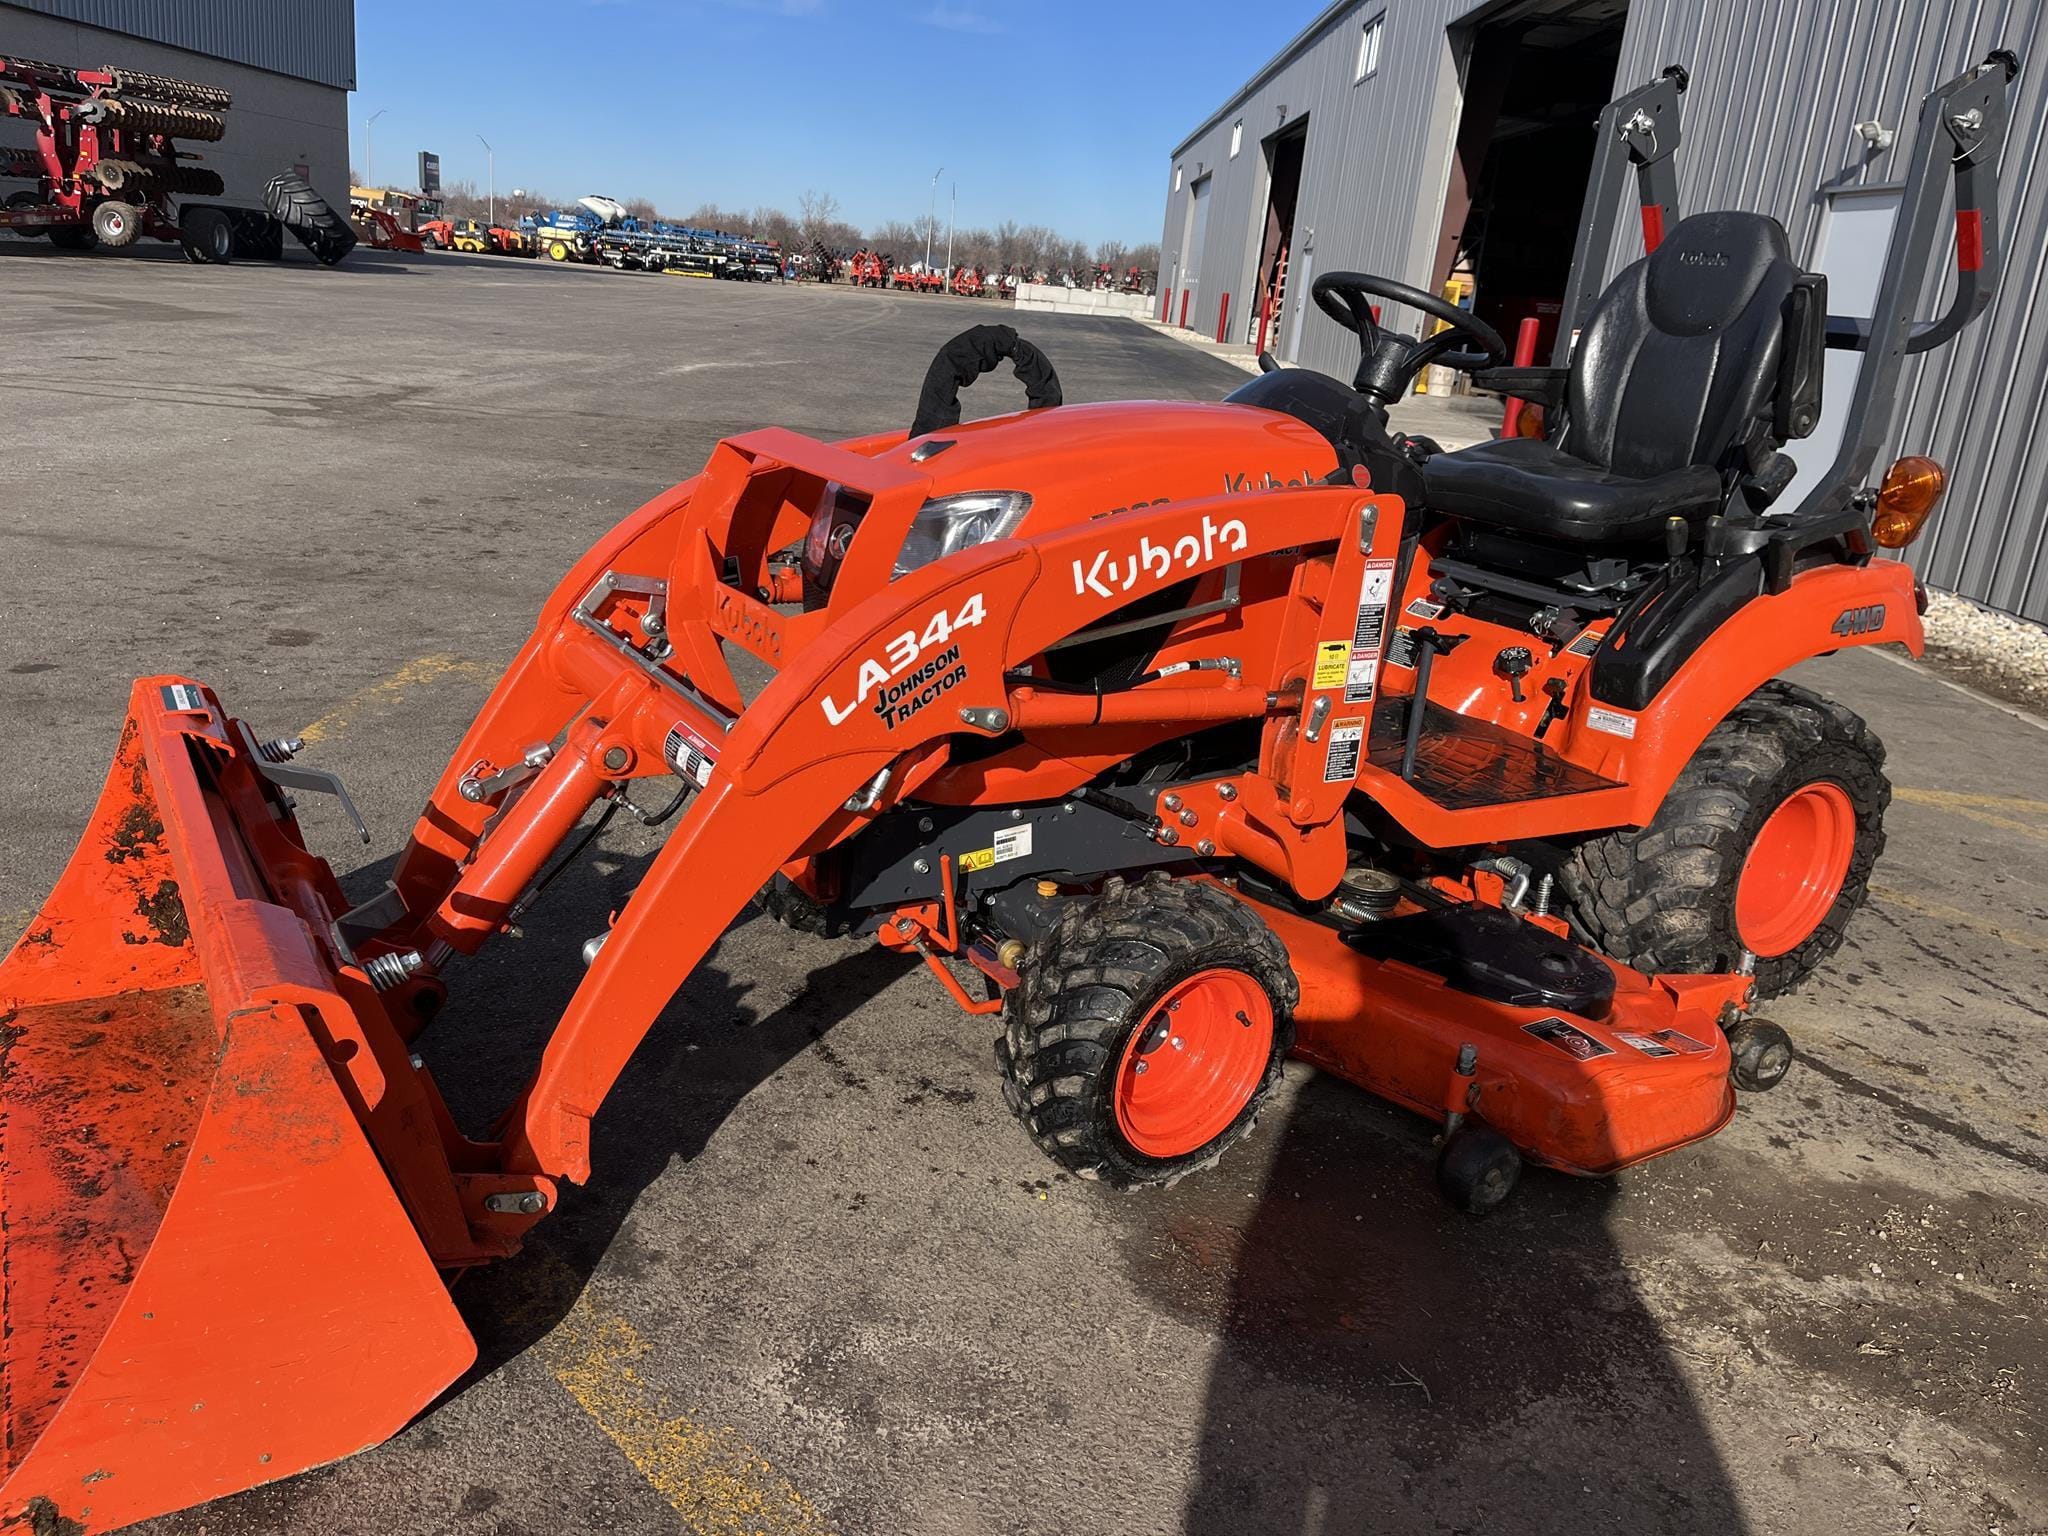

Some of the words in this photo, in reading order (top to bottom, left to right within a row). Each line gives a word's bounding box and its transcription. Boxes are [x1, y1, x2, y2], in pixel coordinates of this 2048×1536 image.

[1073, 516, 1247, 598] Kubota
[1831, 604, 1886, 637] 4WD
[821, 592, 986, 727] LA344
[874, 644, 960, 714] JOHNSON
[1318, 663, 1345, 671] LUBRICATE
[1357, 652, 1377, 660] DANGER
[881, 664, 967, 731] TRACTOR
